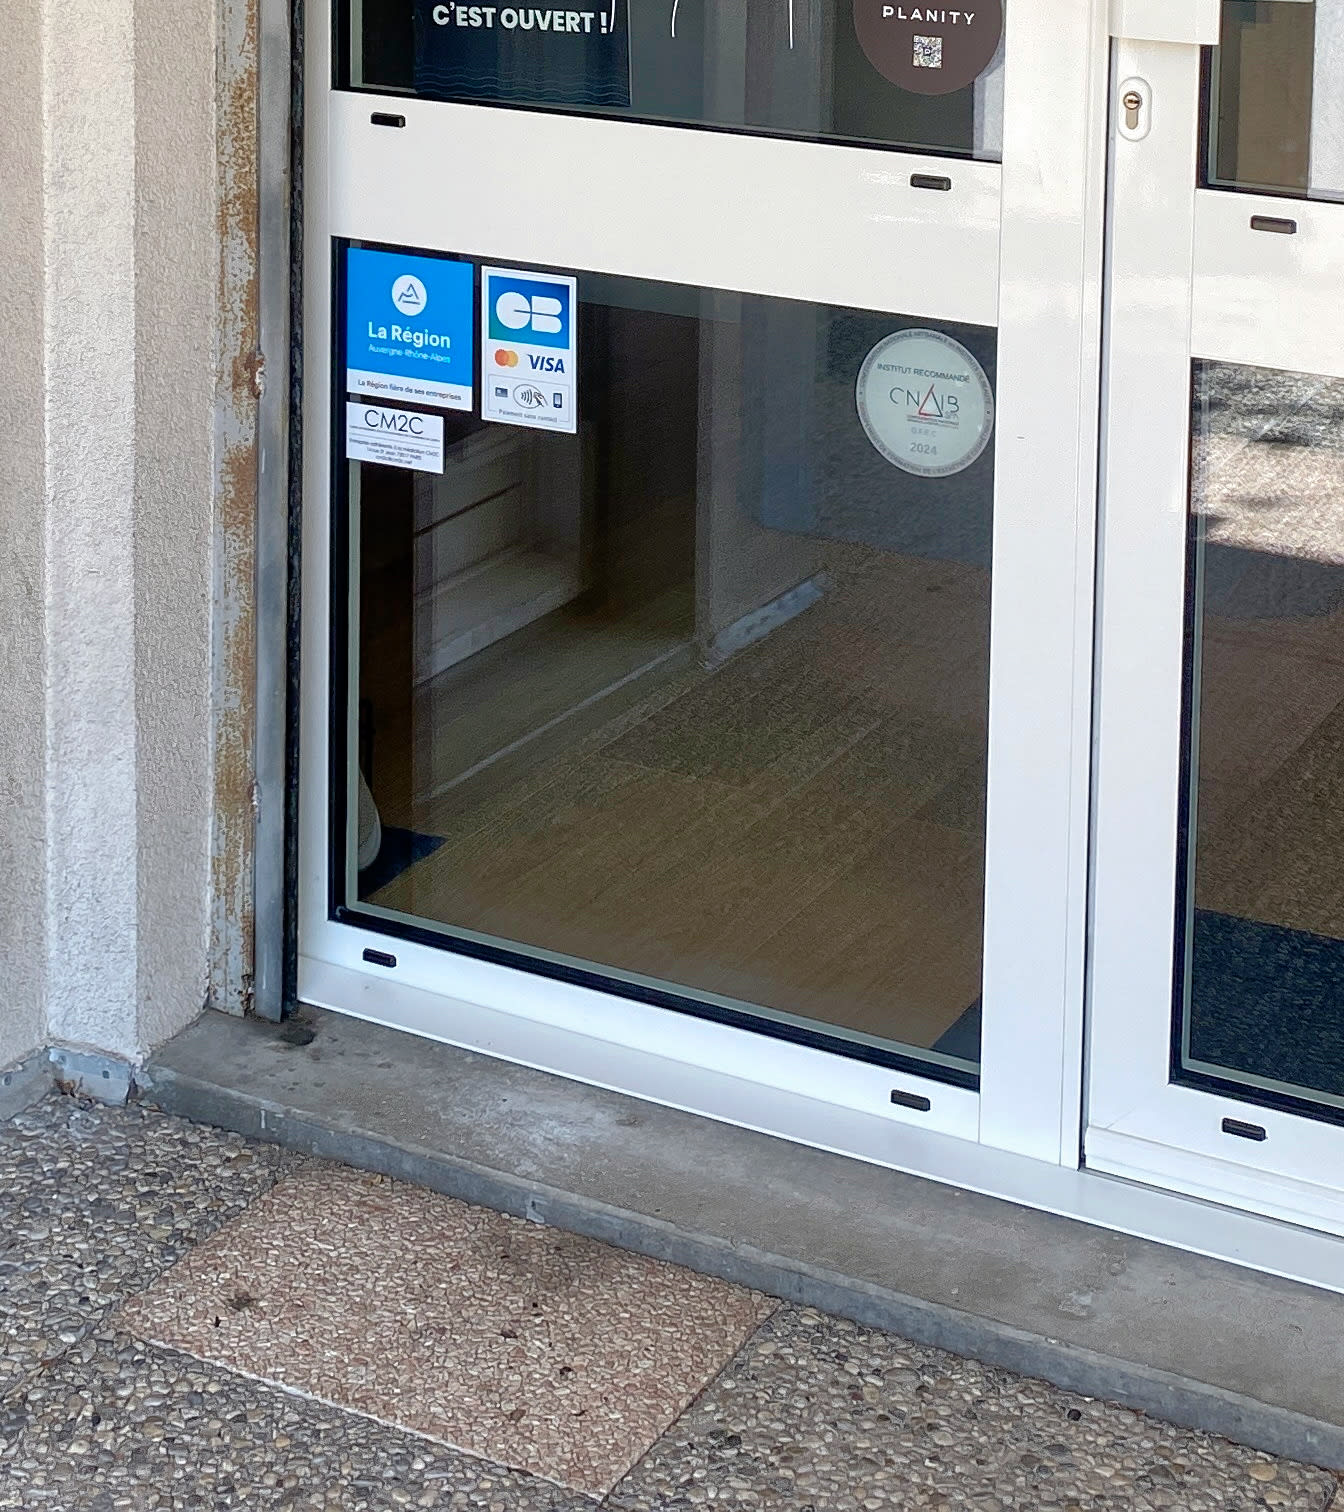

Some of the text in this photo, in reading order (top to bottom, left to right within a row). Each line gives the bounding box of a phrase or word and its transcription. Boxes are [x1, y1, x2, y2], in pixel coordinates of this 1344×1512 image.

[500, 7, 595, 33] OUVERT
[600, 12, 608, 34] !
[882, 5, 976, 26] PLANITY
[367, 321, 451, 350] La Région
[527, 354, 565, 374] VISA
[877, 362, 971, 383] INSTITUT RECOMMANDÉ
[367, 380, 388, 391] Région
[364, 409, 424, 435] CM2C
[910, 442, 937, 456] 2024
